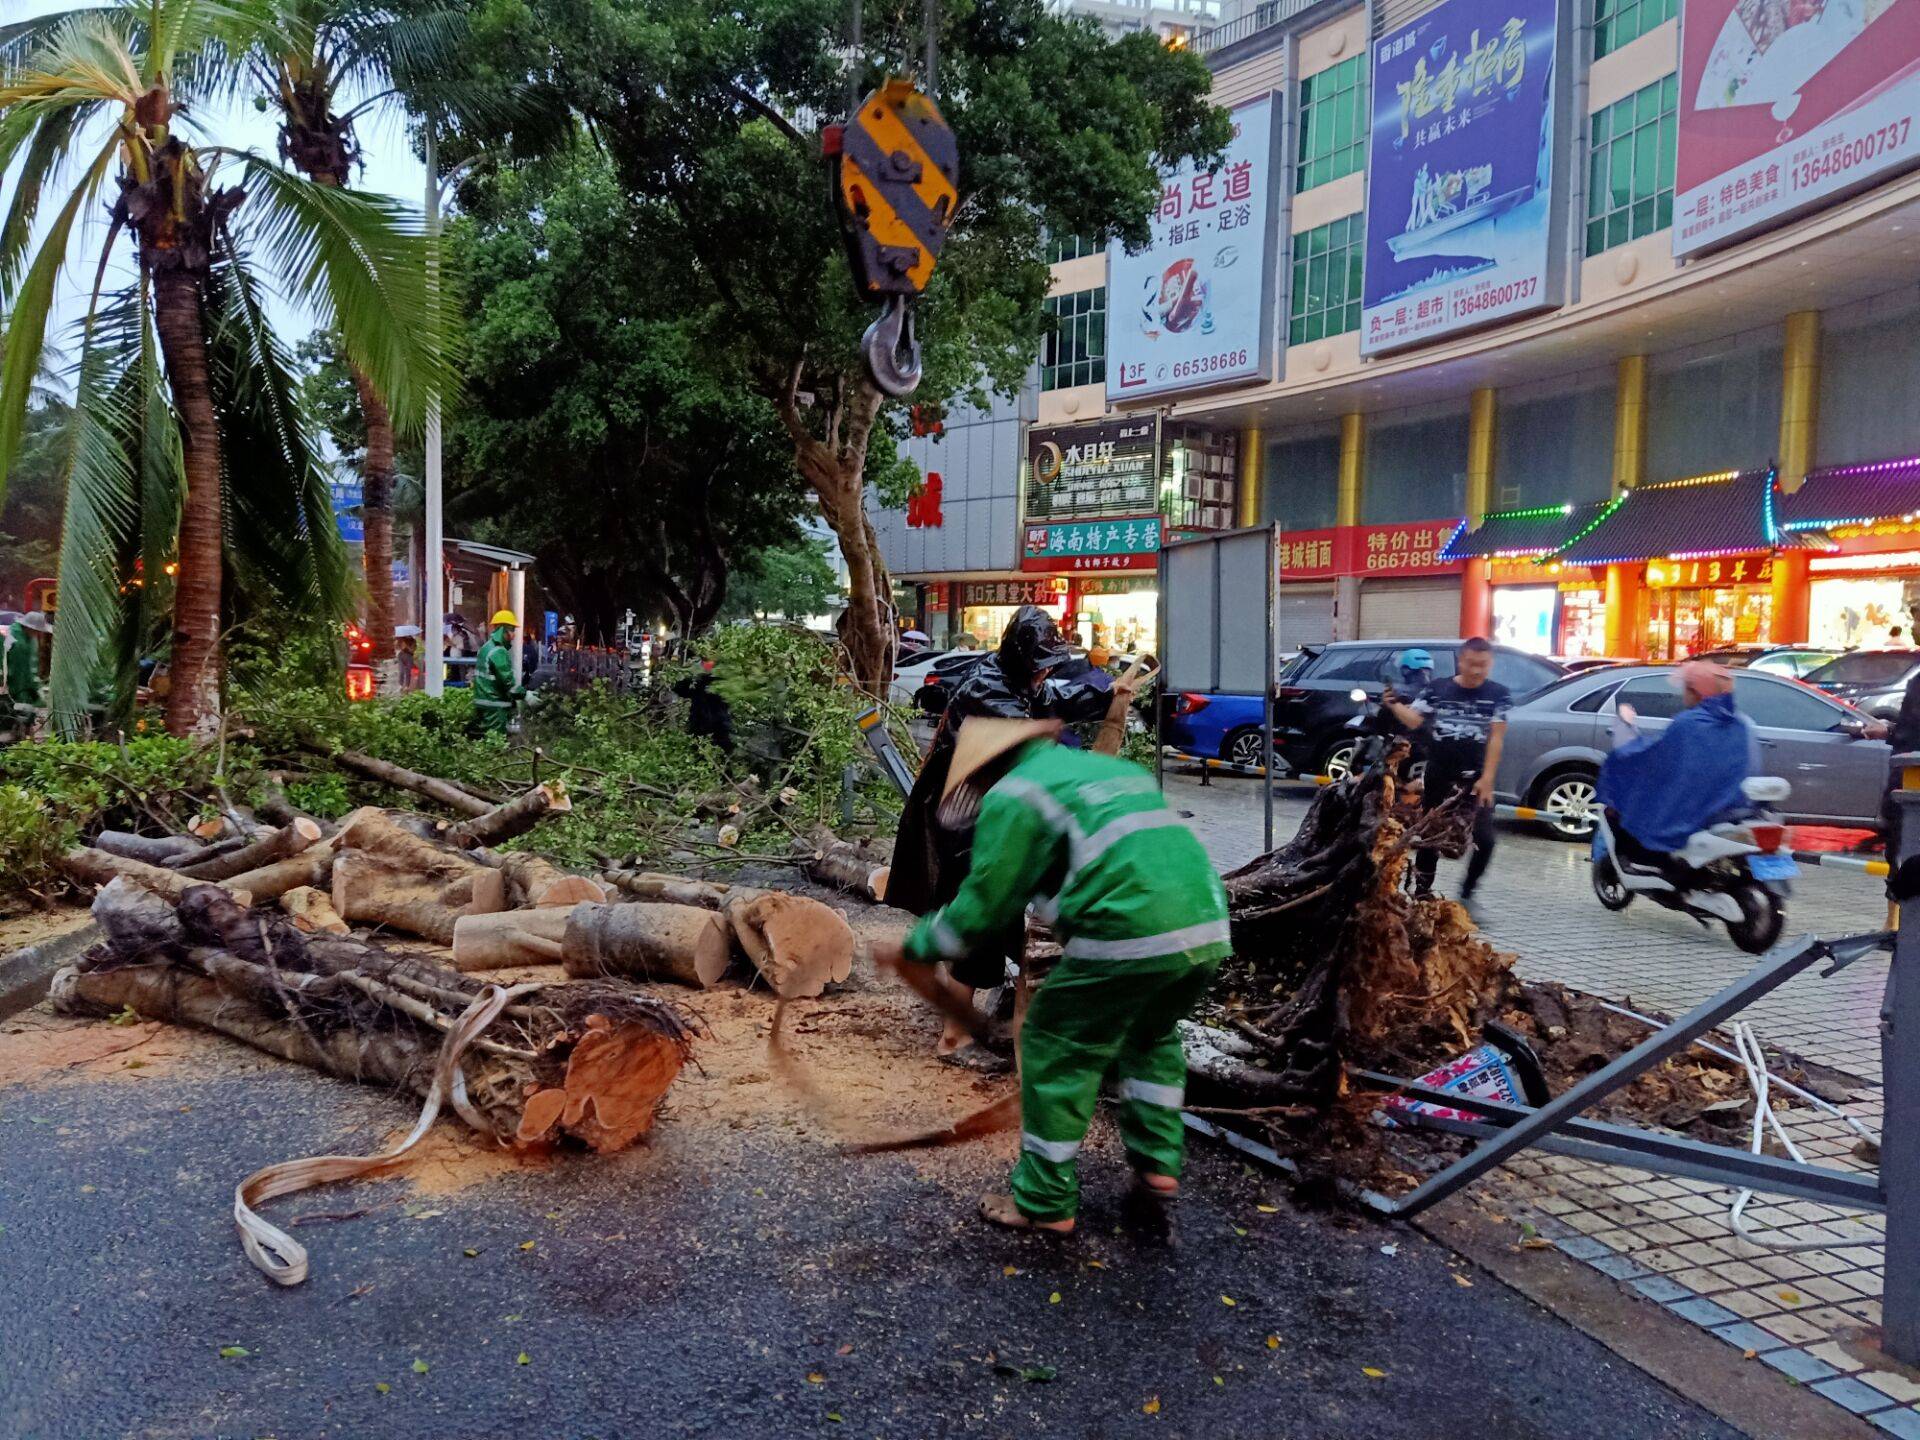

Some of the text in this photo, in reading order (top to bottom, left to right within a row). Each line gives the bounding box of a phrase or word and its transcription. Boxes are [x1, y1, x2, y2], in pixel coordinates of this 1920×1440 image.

[1413, 108, 1472, 151] 共赢未来
[1791, 116, 1912, 192] 13648600737
[1452, 276, 1538, 319] 13648600737
[1129, 349, 1247, 379] 3F 66538686
